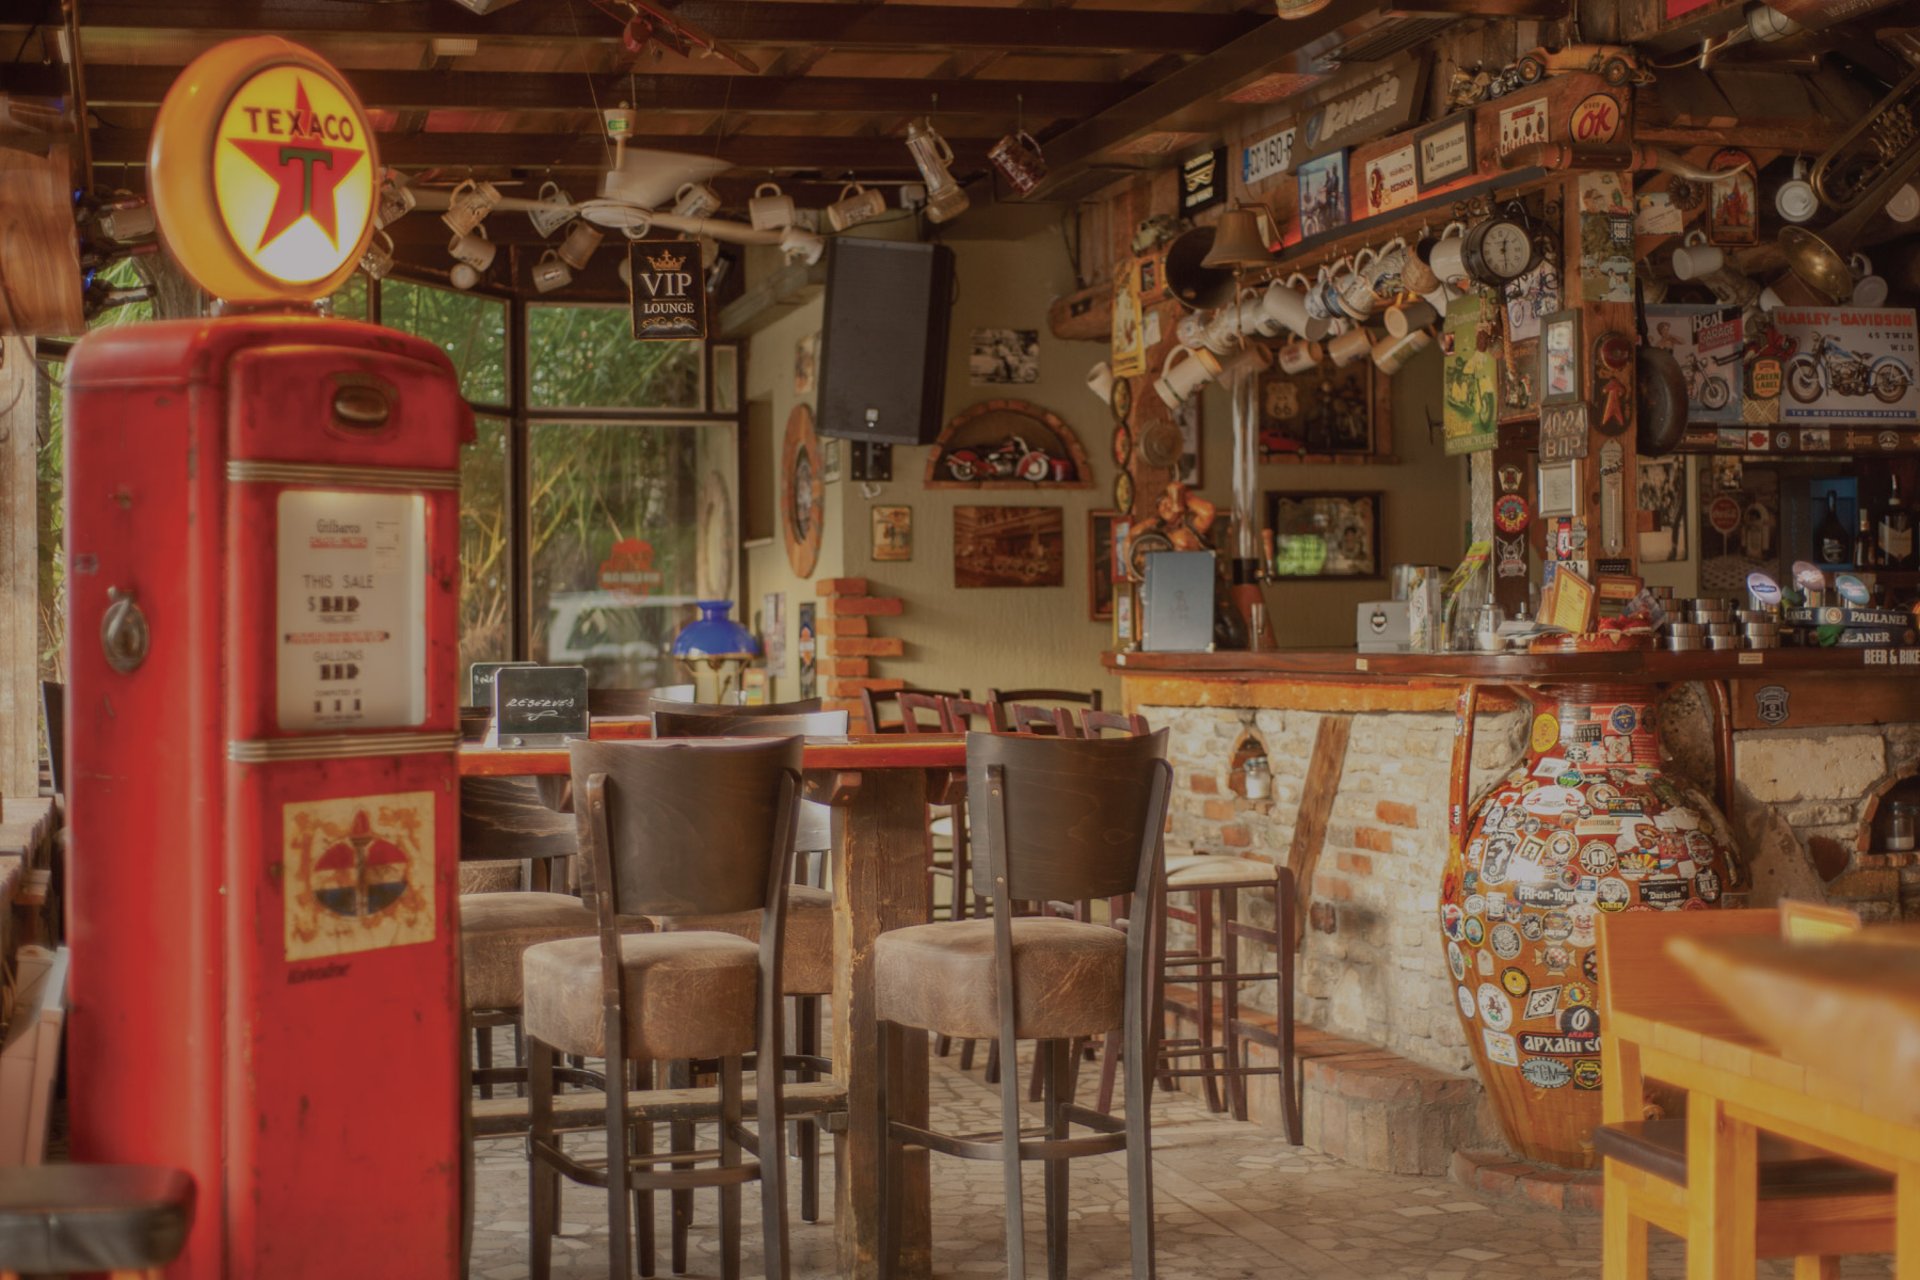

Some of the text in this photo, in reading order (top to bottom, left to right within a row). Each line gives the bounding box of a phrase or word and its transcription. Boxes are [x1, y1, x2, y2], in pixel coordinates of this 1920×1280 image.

[242, 105, 354, 142] TEXACO
[1578, 103, 1612, 140] OK
[640, 273, 693, 297] VIP
[644, 302, 696, 314] LOUNGE
[1690, 310, 1724, 332] Best
[1777, 311, 1914, 327] HARLEY-DAVIDSON
[1886, 332, 1914, 341] TWIN
[1755, 373, 1780, 381] GREEN
[1756, 381, 1779, 390] LABEL
[1791, 409, 1809, 417] THE
[1872, 410, 1911, 418] SUPREME
[316, 518, 361, 534] Gilbarco
[303, 575, 374, 588] THIS SALE
[1851, 611, 1907, 625] PAULANER
[313, 651, 363, 662] GALLONS
[1864, 650, 1888, 665] BEER
[1891, 650, 1898, 665] &
